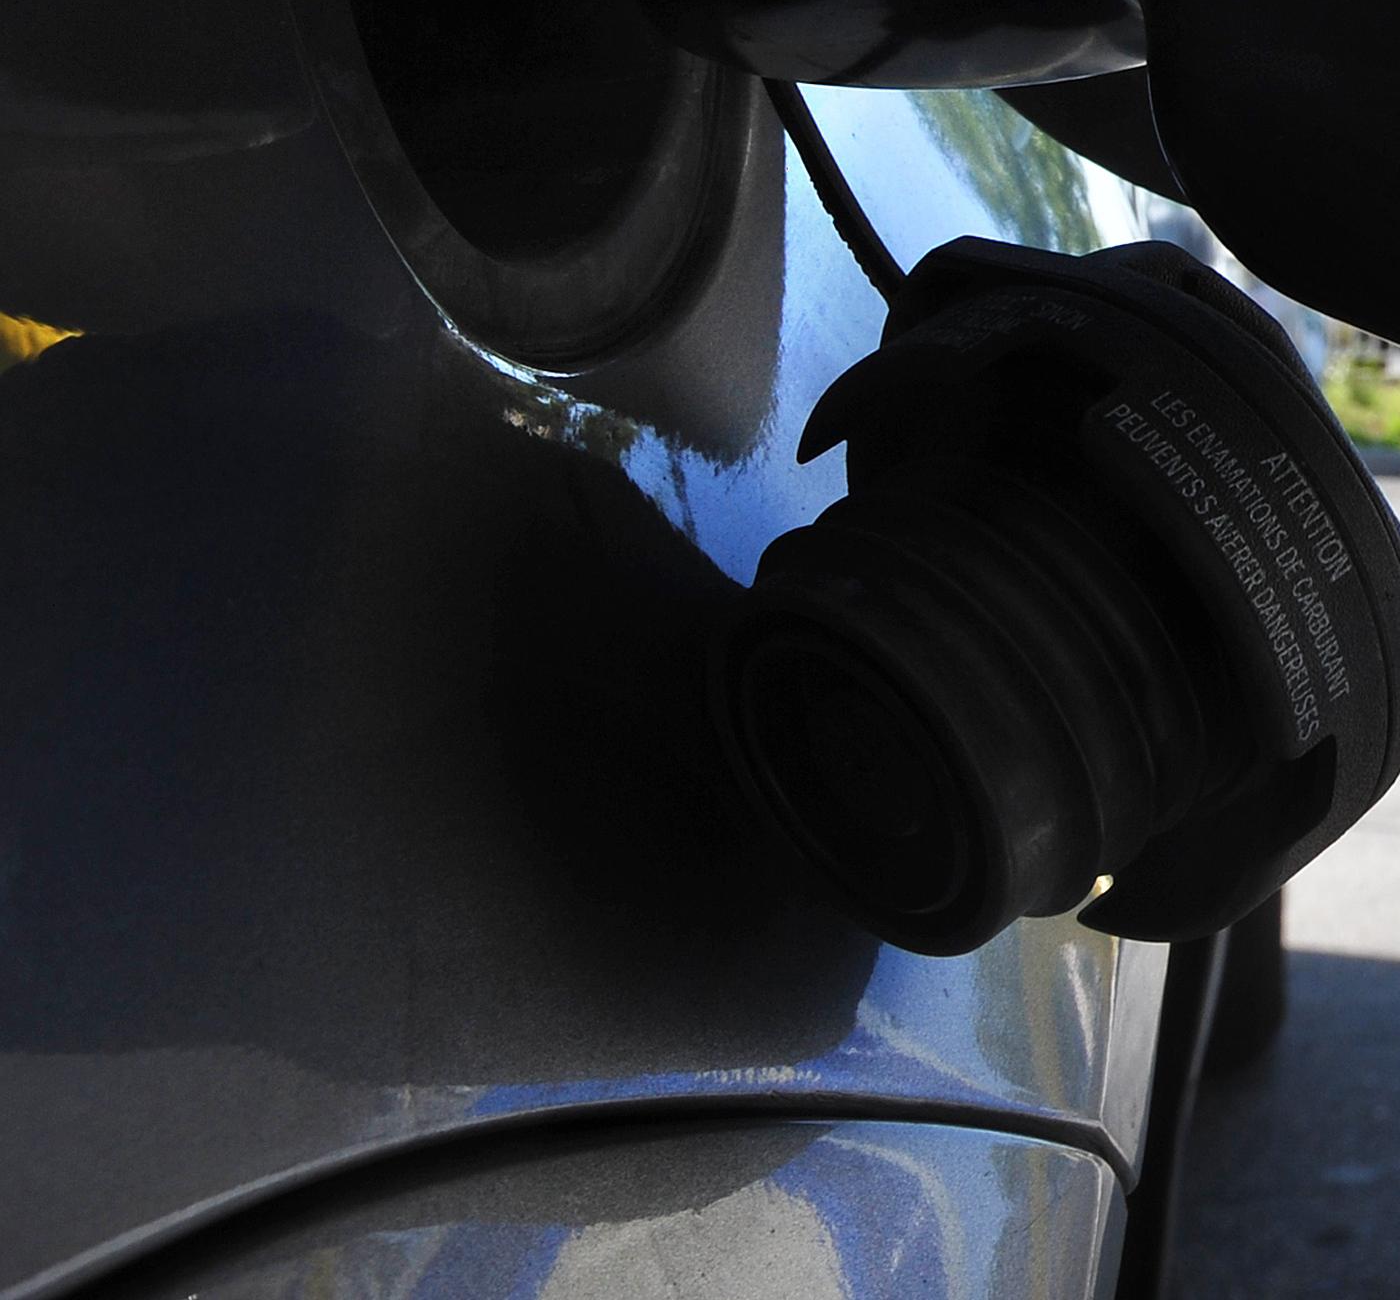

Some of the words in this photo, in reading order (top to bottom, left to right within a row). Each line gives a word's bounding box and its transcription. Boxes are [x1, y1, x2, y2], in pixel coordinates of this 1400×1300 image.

[1104, 403, 1206, 498] PEUVENTS
[1204, 514, 1268, 593] AVERER
[1252, 586, 1320, 742] DANGEREUSES
[1151, 391, 1196, 428] LES
[1186, 422, 1288, 550] ENAMATIONS
[1275, 545, 1306, 580] DE
[1293, 577, 1350, 702] CARBURANT
[1261, 452, 1352, 582] ATTENTION
